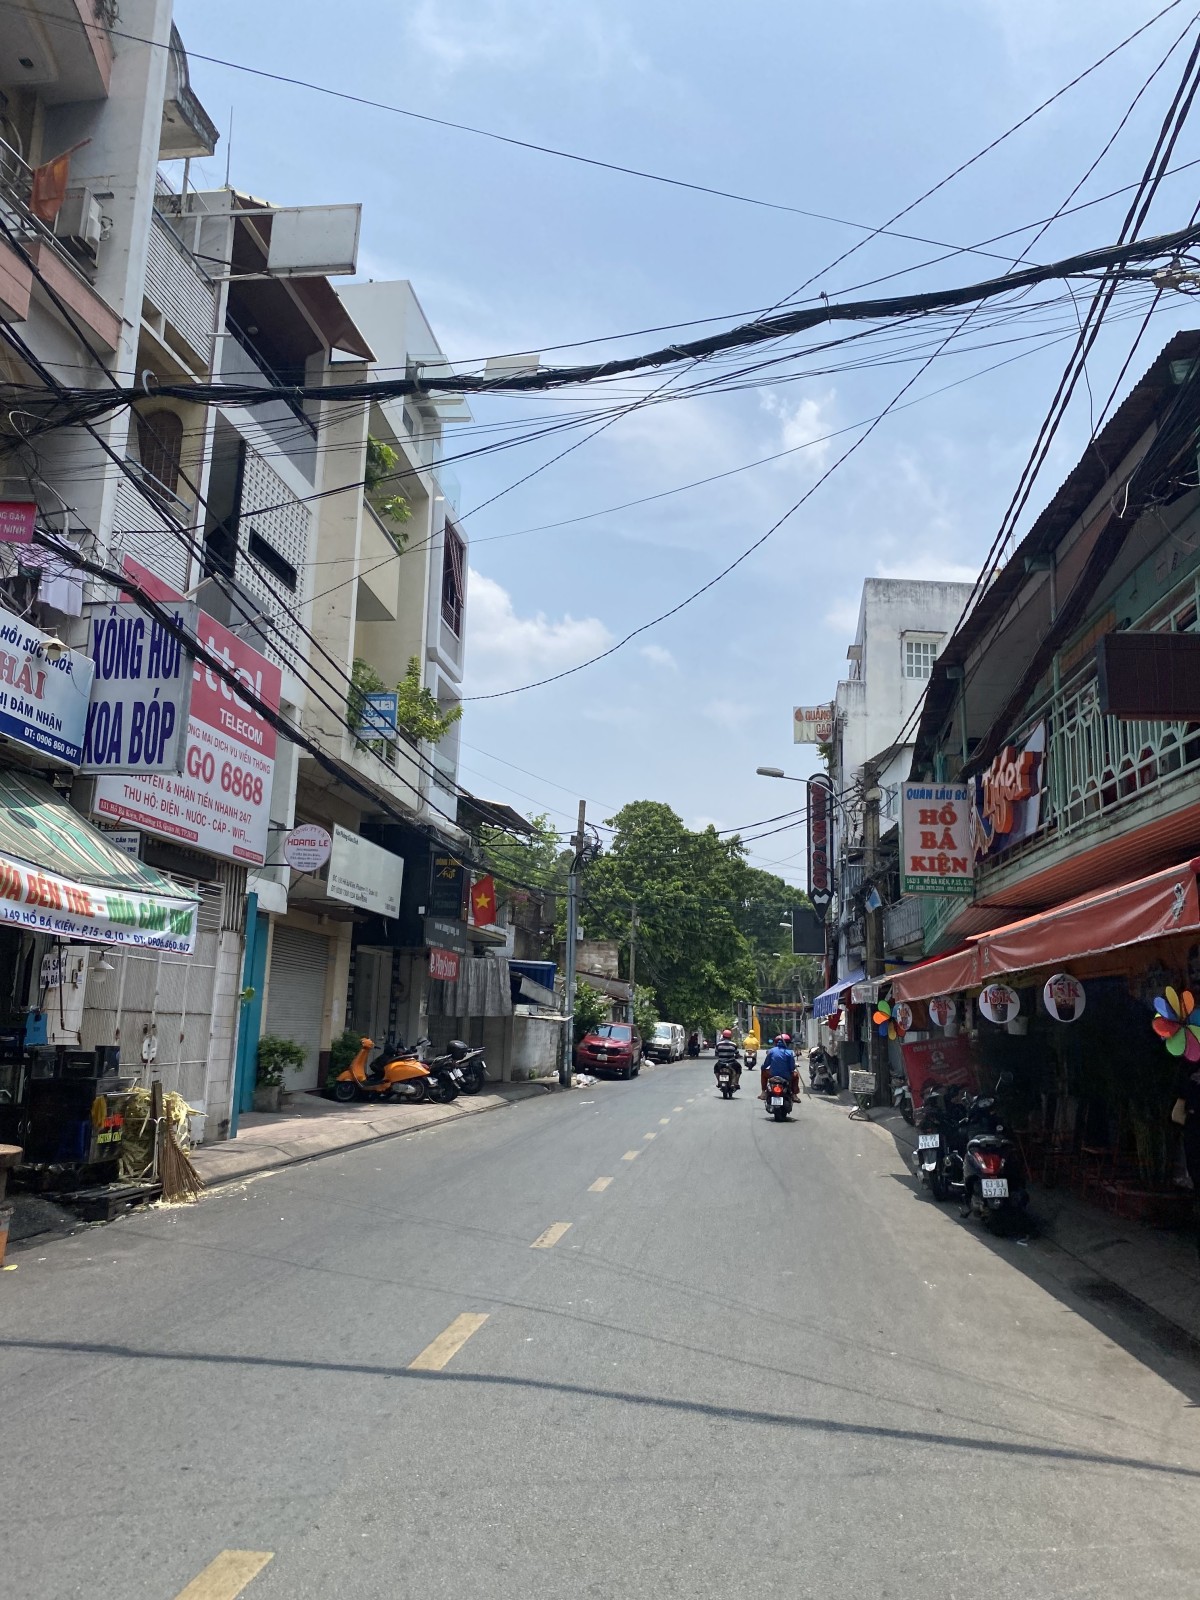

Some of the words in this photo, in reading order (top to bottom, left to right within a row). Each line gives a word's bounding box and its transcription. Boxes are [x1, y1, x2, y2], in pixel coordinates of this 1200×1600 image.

[0, 624, 22, 648] HỒI
[23, 637, 45, 659] SỨC
[93, 606, 144, 680] XÔNG
[147, 611, 184, 679] HƠI
[11, 695, 33, 718] ĐẢM
[36, 710, 62, 732] NHẬN
[82, 701, 123, 764] XOA
[128, 688, 175, 764] BÓP
[220, 708, 263, 746] TELECOM
[24, 726, 35, 739] ĐT:
[36, 732, 53, 747] 0906
[53, 740, 65, 753] 860
[65, 745, 77, 758] 847
[214, 737, 229, 752] DỊCH
[252, 757, 271, 775] THÔNG
[187, 744, 215, 784] GO
[221, 760, 264, 806] 6868
[981, 745, 1032, 834] Tiger
[124, 784, 142, 802] THU
[144, 791, 158, 811] HỘ:
[161, 799, 180, 817] ĐIỆN
[185, 809, 207, 828] NƯỚC
[212, 818, 227, 834] CÁP
[166, 780, 172, 793] &
[174, 784, 195, 804] NHẬN
[215, 800, 238, 820] NHANH
[239, 810, 251, 825] 24/7
[920, 827, 957, 850] BÁ
[910, 852, 968, 876] KIỆN
[25, 871, 63, 910] BẾN
[62, 885, 96, 918] TRE
[4, 908, 20, 920] 149
[40, 915, 52, 927] BÁ
[82, 925, 99, 937] P.15
[105, 930, 124, 941] Q.10
[134, 934, 146, 944] ĐT:
[983, 990, 1014, 1004] 18K
[1047, 981, 1081, 998] 15K
[984, 1188, 1007, 1196] 357.37
